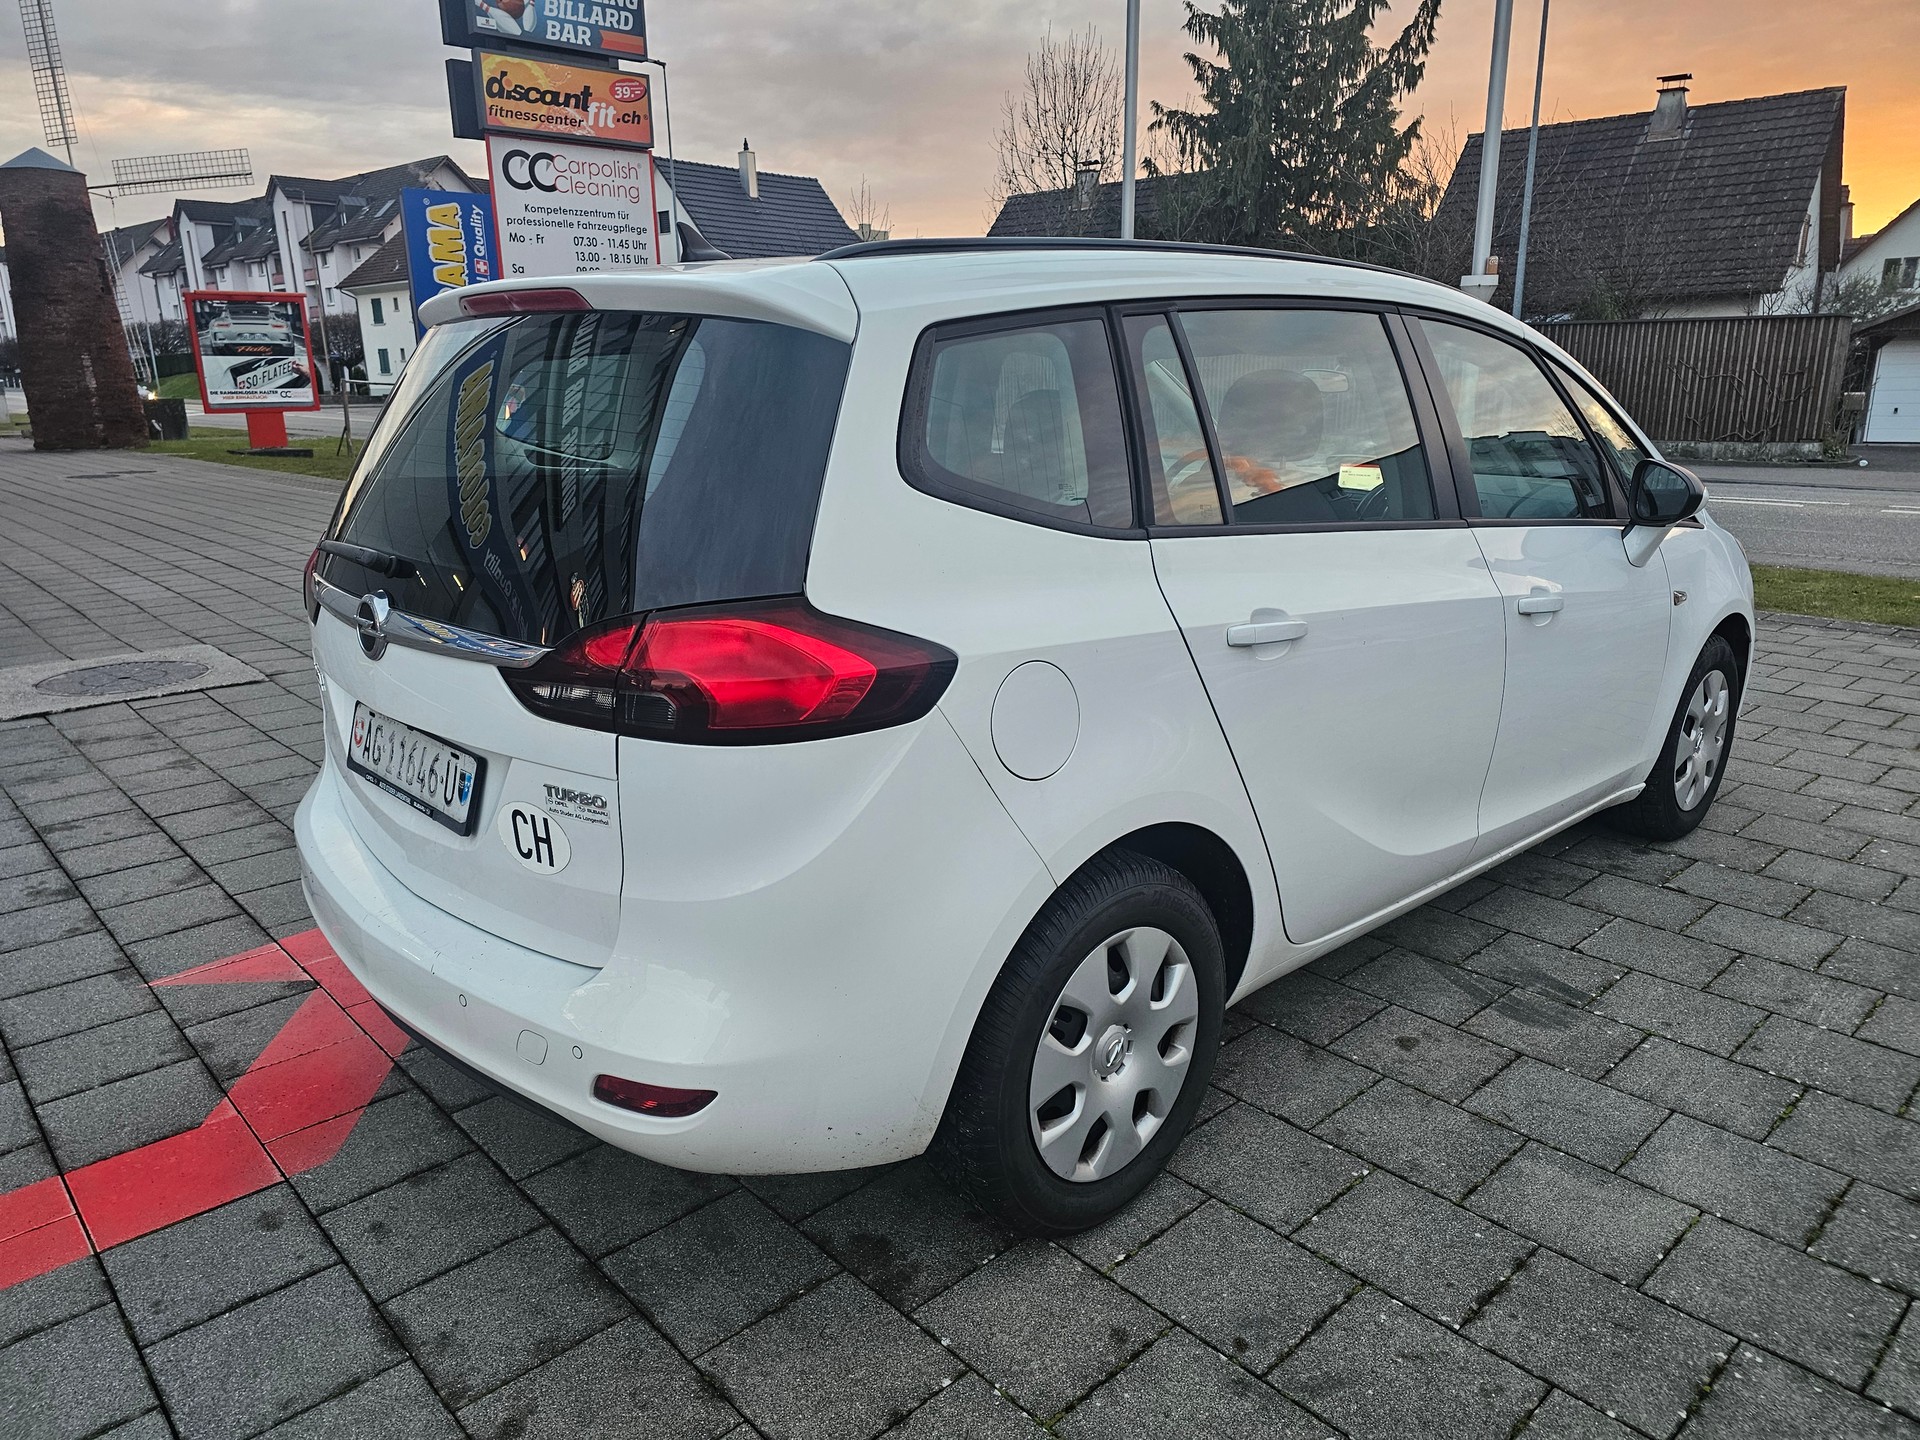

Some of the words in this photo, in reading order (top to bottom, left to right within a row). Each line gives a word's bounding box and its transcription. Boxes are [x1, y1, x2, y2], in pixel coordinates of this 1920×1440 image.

[543, 0, 634, 31] BILLARD
[545, 20, 592, 46] BAR
[488, 104, 584, 128] fitnesscenter
[552, 154, 639, 180] Carpolish
[554, 174, 640, 204] Cleaning
[524, 203, 616, 220] Kompetenzzentrum
[617, 210, 630, 220] für
[470, 204, 486, 257] Quality
[506, 215, 575, 229] professionelle
[577, 220, 648, 236] Fahrzeugpflege
[426, 202, 469, 292] AMA
[508, 231, 526, 243] Mo
[535, 233, 545, 244] Fr
[573, 236, 598, 248] 07.30
[607, 238, 630, 250] 11.45
[632, 240, 647, 250] Uhr
[512, 263, 525, 274] Sa
[575, 251, 600, 263] 13.00
[609, 253, 632, 265] 18.15
[633, 254, 649, 265] Uhr
[543, 784, 607, 809] TURBO
[511, 809, 555, 867] CH
